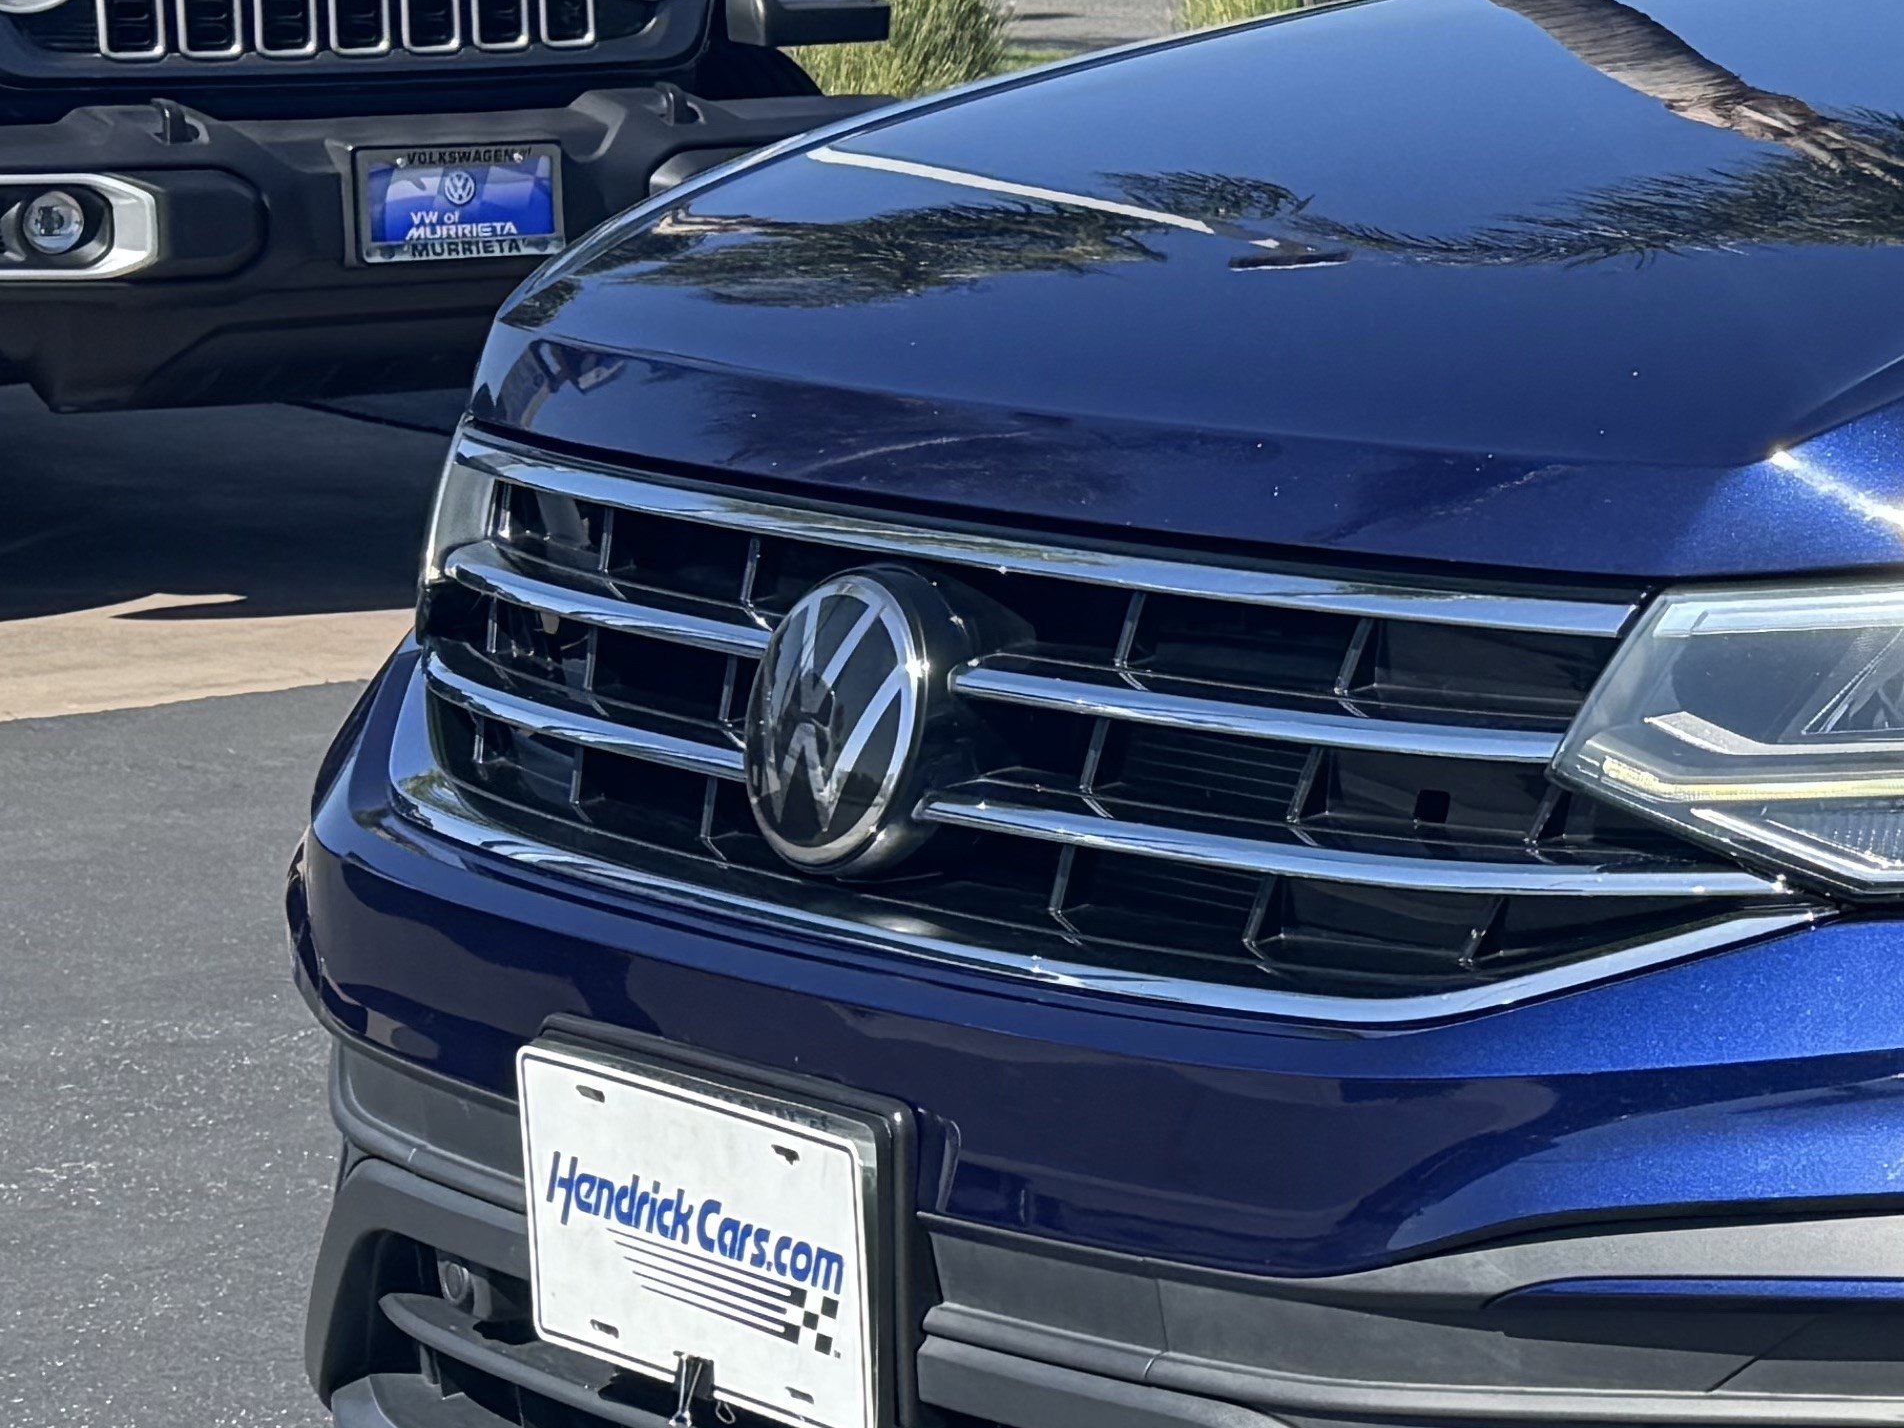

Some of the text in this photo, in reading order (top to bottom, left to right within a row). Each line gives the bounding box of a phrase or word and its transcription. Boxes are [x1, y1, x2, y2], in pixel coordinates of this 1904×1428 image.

[407, 148, 516, 165] VOLKSWAGEN
[410, 211, 459, 225] VW of
[405, 222, 518, 240] MURRIETA
[411, 240, 521, 258] MURRIETA
